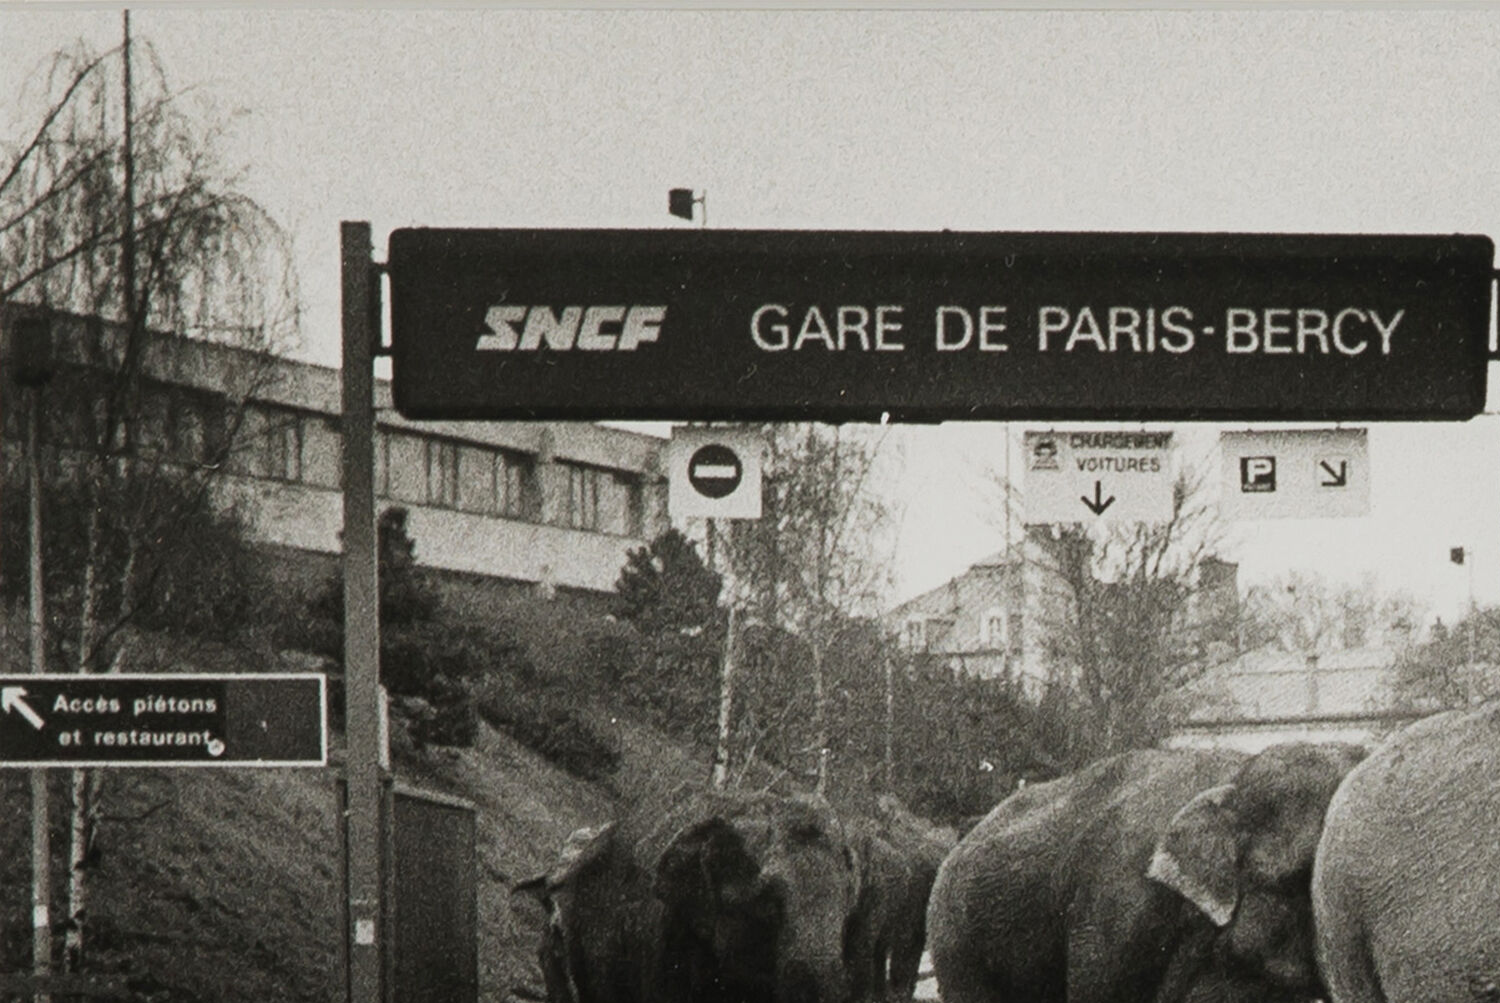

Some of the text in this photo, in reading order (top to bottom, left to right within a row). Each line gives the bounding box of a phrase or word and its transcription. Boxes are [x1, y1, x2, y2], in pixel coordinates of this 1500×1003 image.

[475, 304, 1406, 356] SNCF GARE DE PARIS-BERCY
[1076, 457, 1161, 473] VOITURES
[1247, 459, 1272, 484] P
[53, 694, 218, 717] Accès piétons
[59, 729, 211, 747] et restaurant
